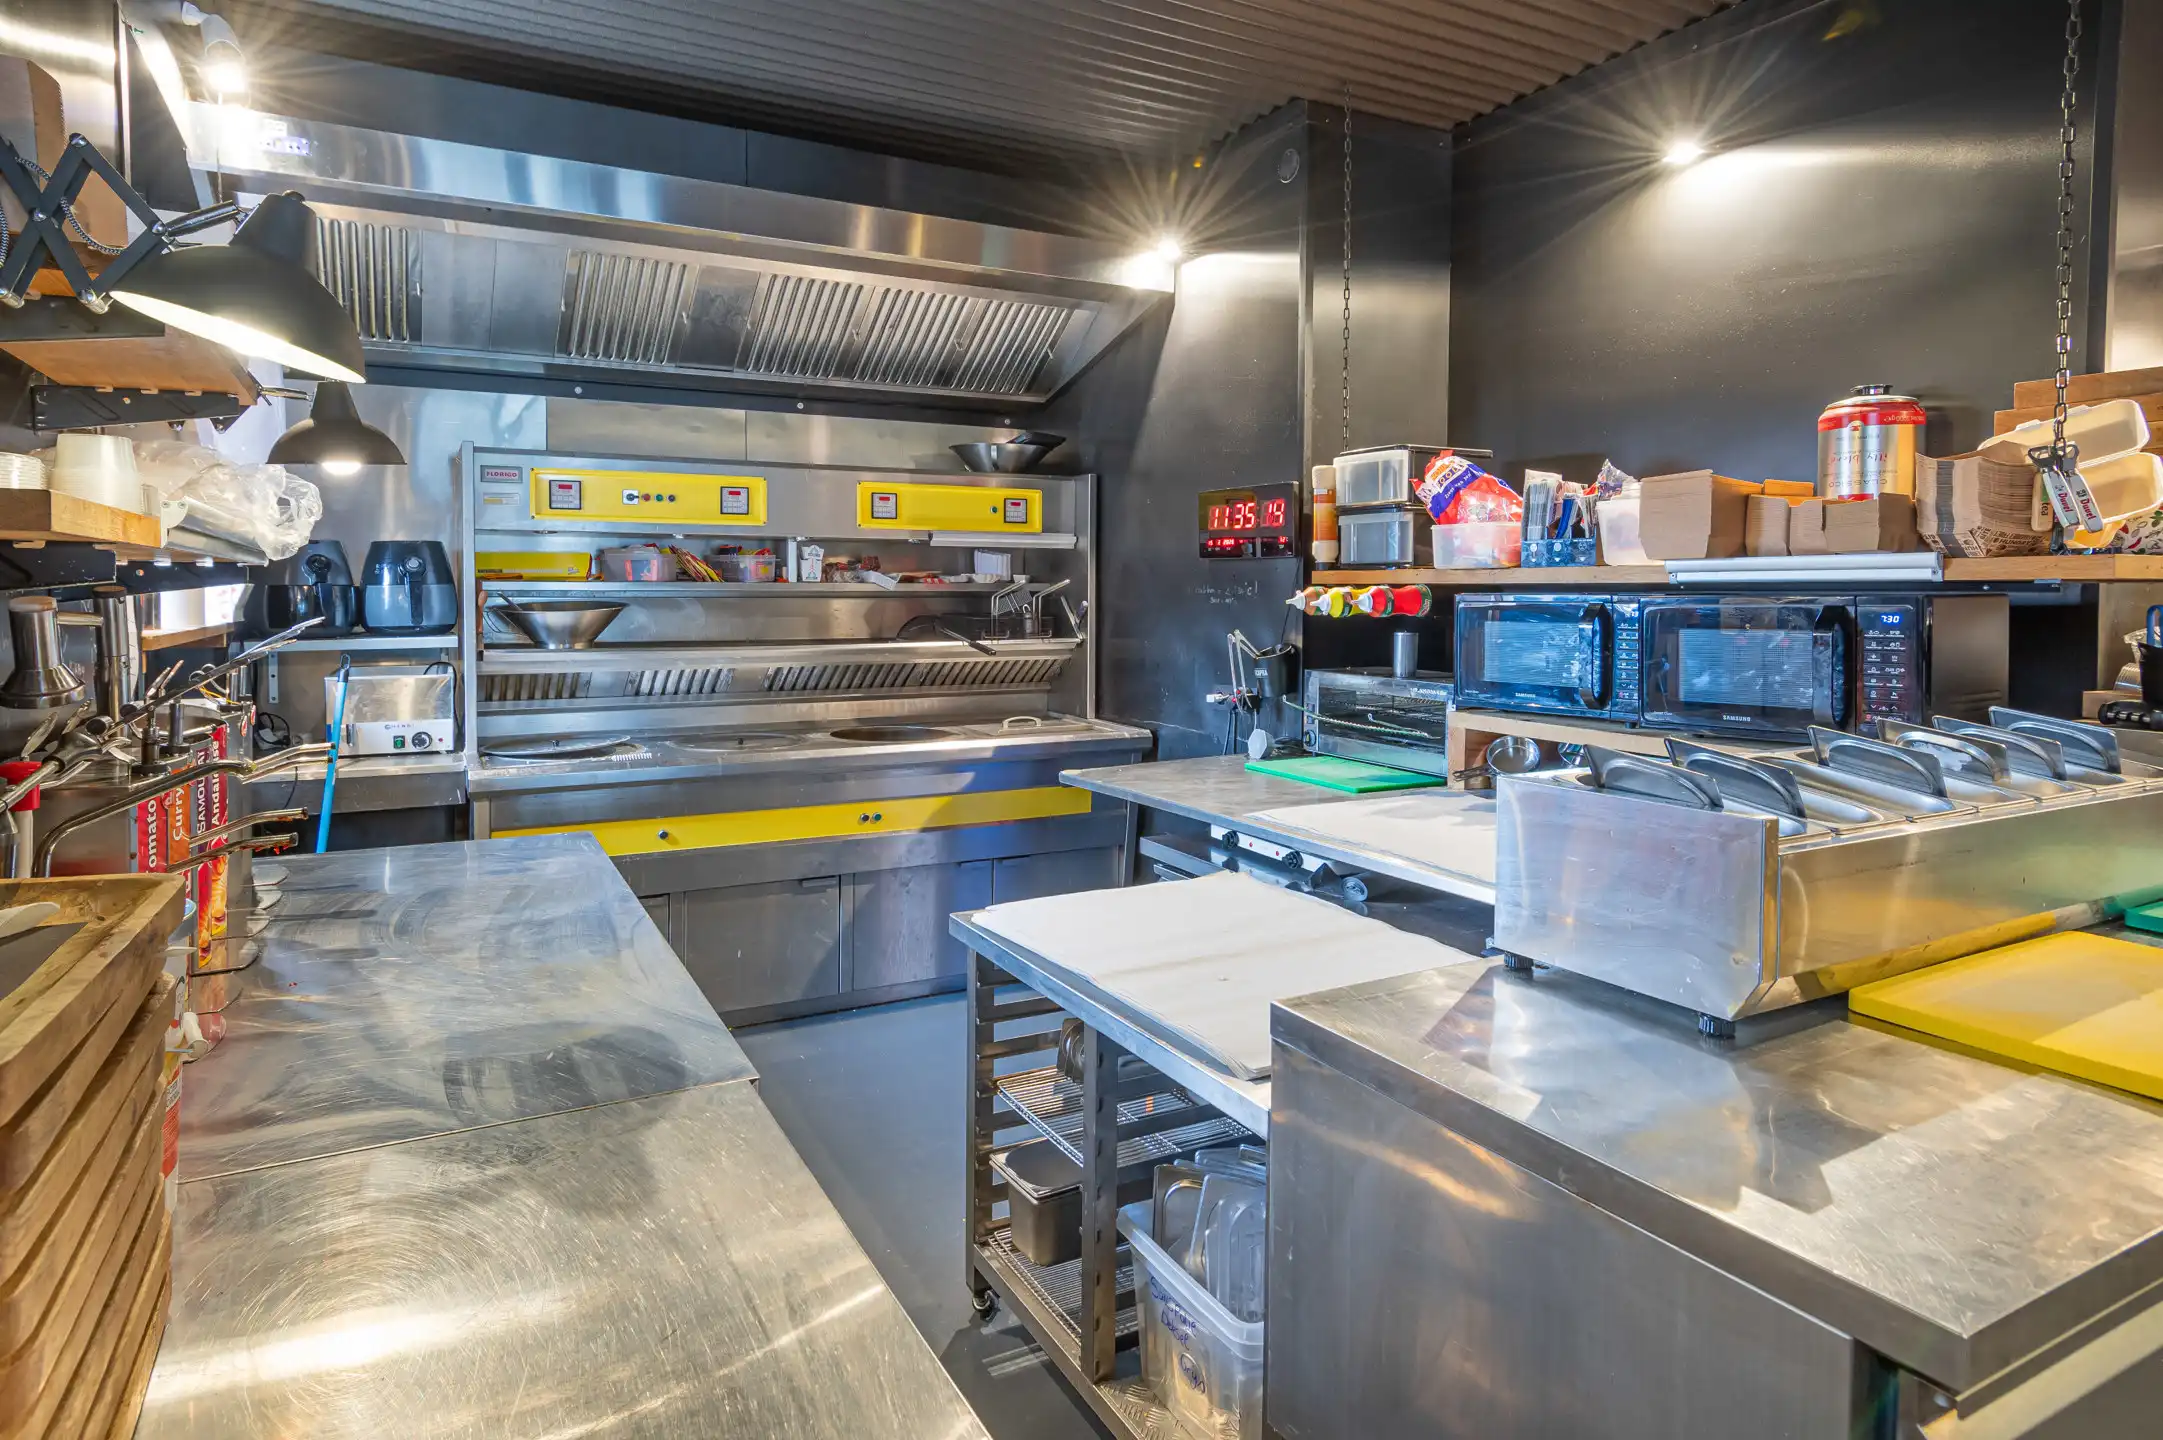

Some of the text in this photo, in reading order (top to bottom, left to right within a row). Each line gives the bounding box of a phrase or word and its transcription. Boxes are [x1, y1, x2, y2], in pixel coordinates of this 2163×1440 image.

[1829, 479, 1887, 487] CLASSICO
[2058, 492, 2074, 513] Duvel
[2080, 498, 2096, 520] Duvel
[1880, 615, 1900, 623] 7:30
[196, 751, 206, 834] SAMOUAY
[173, 787, 185, 841] Curry
[148, 800, 157, 873] omato
